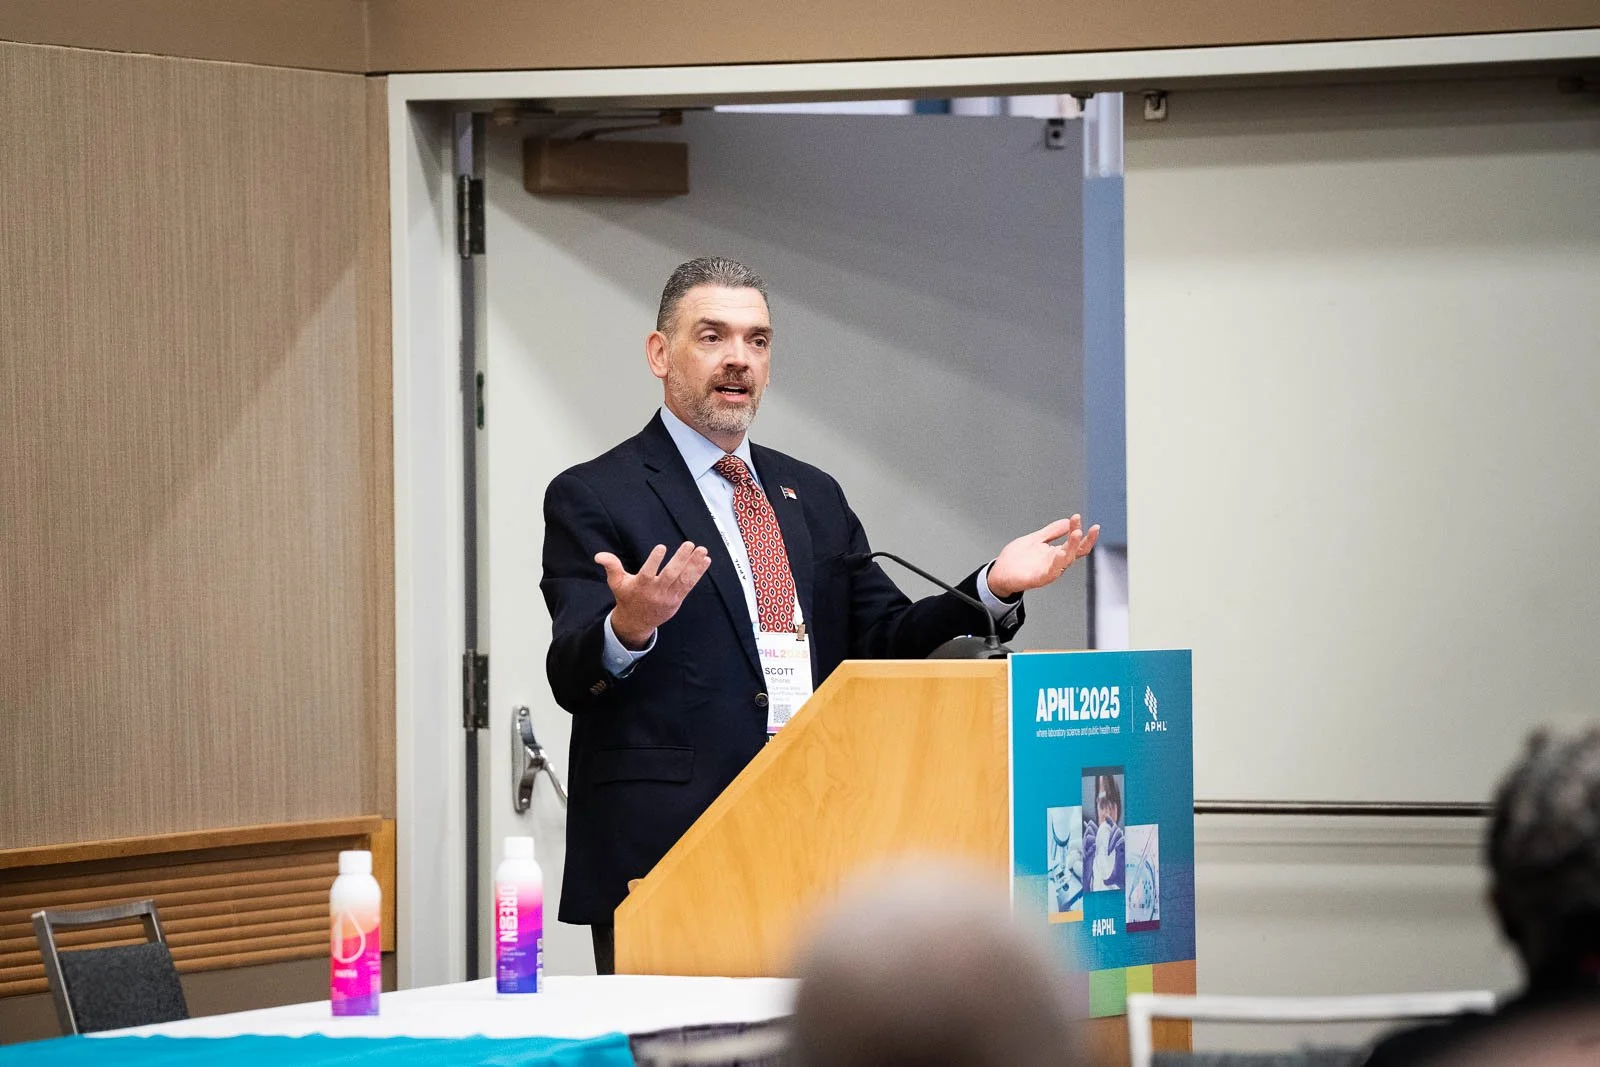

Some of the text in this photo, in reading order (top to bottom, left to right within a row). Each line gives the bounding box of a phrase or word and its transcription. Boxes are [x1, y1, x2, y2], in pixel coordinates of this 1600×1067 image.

[764, 667, 794, 676] SCOTT
[1144, 721, 1167, 732] APHL
[1092, 917, 1116, 937] #APHL
